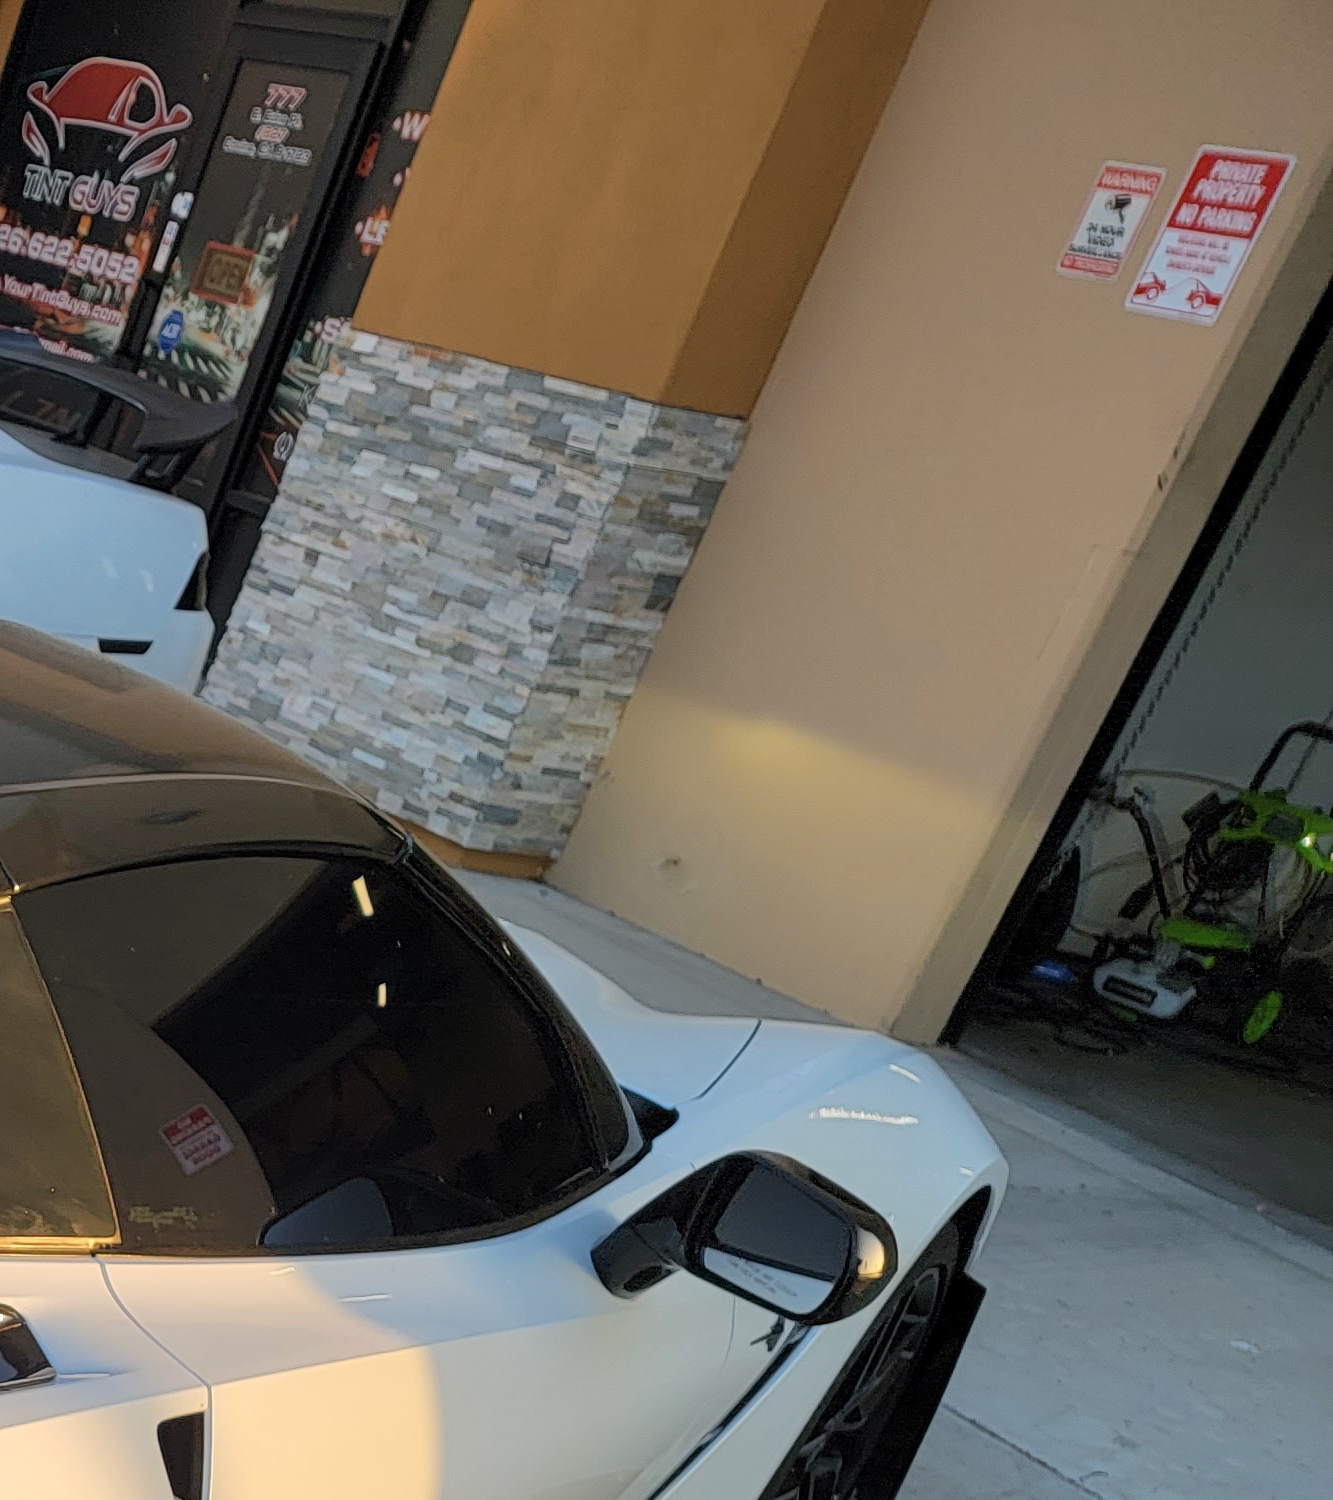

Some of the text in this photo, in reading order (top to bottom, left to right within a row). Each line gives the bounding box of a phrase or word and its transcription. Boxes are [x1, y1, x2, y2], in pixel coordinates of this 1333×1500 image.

[264, 83, 308, 111] 777
[1101, 172, 1159, 193] WARNING
[1209, 159, 1269, 184] PRIVATE
[22, 163, 74, 206] TINT
[69, 174, 140, 222] GUYS
[1193, 178, 1268, 207] PROPERTY
[1175, 202, 1258, 233] NO PARKING
